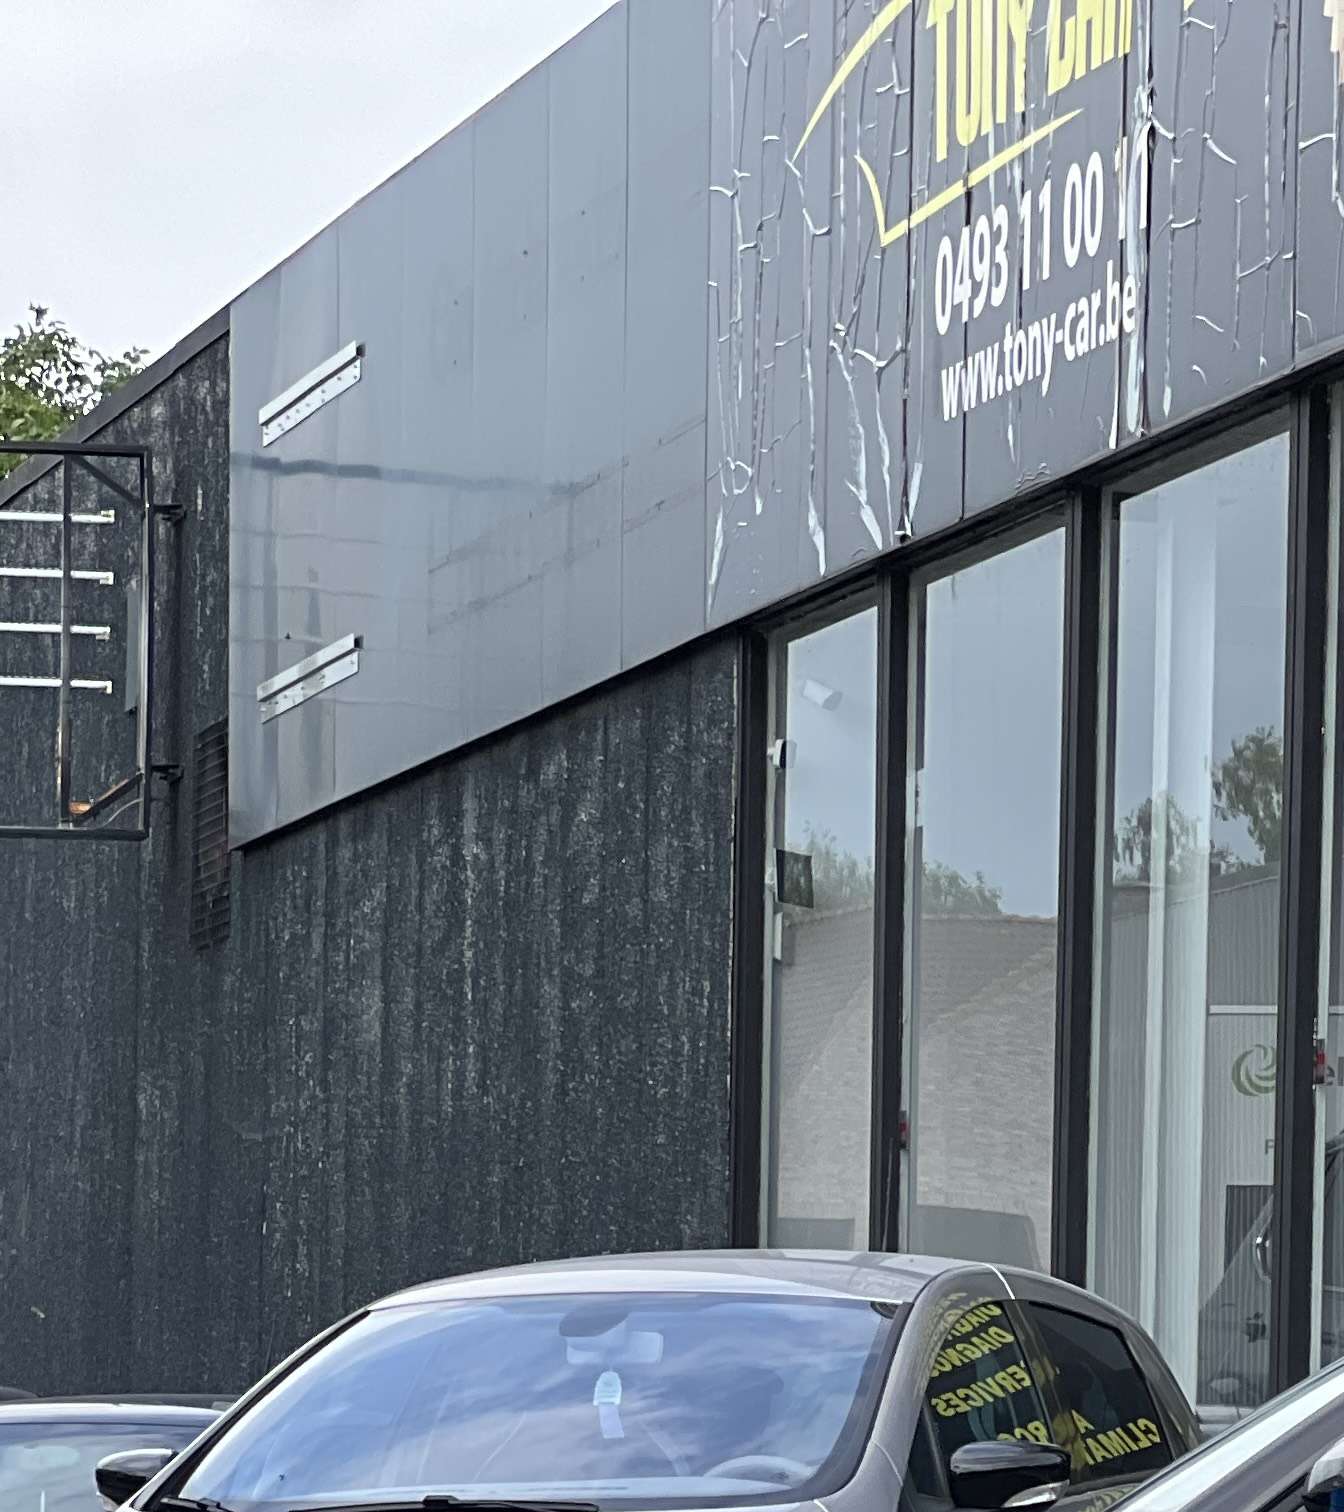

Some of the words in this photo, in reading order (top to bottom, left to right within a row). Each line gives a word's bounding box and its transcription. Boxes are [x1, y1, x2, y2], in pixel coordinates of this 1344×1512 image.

[935, 203, 1009, 336] 0493
[1019, 178, 1052, 292] 11
[1063, 151, 1104, 269] 00
[941, 259, 1138, 422] www.tony-car.be
